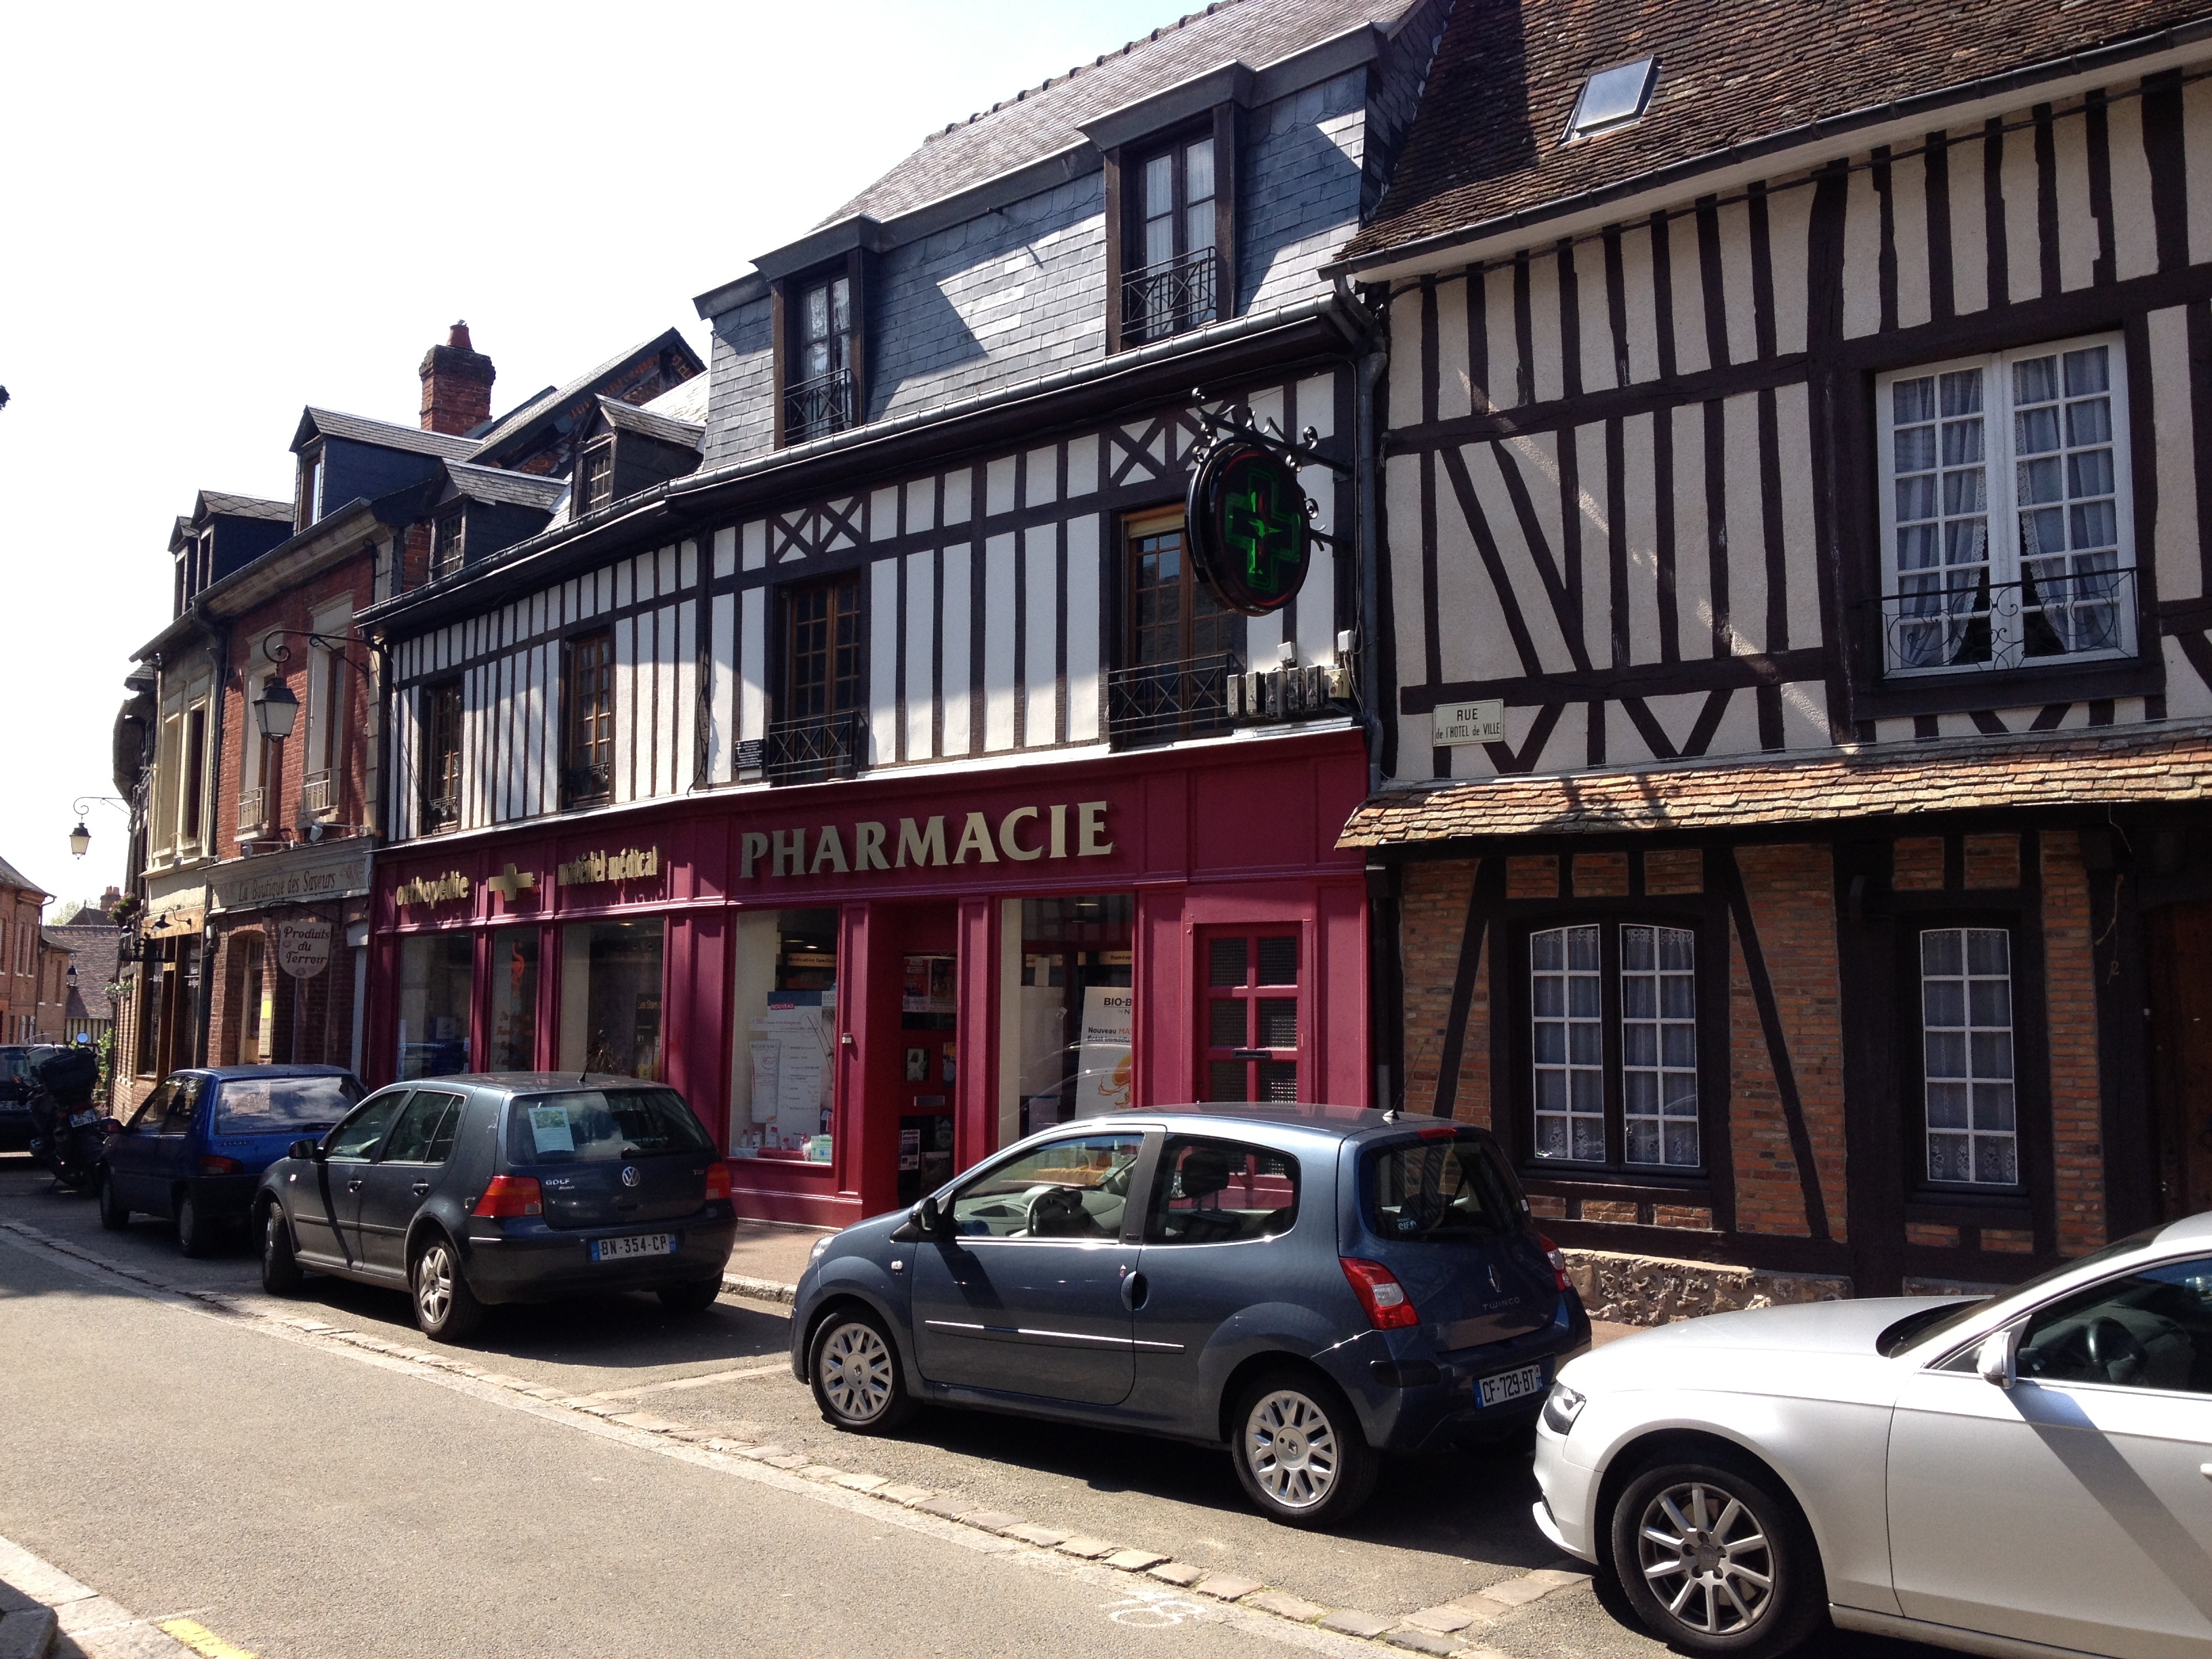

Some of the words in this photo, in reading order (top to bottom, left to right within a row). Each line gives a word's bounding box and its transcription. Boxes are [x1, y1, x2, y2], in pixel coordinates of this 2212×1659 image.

[1456, 708, 1478, 721] RUE
[1435, 728, 1443, 739] de
[1472, 724, 1480, 736] de
[1483, 722, 1500, 735] VILLE
[739, 800, 1114, 879] PHARMACIE
[557, 849, 606, 886] matériel
[608, 845, 658, 880] médical
[239, 882, 248, 902] La
[252, 879, 285, 899] Boutique
[287, 873, 300, 894] des
[303, 870, 335, 892] Saveurs
[396, 871, 470, 909] orthopédie
[283, 926, 331, 940] Produits
[298, 941, 312, 951] du
[286, 951, 327, 964] Terroir
[1088, 1027, 1117, 1035] Nouveau
[545, 1178, 571, 1186] GOLF
[1397, 1221, 1410, 1230] elf
[1481, 1296, 1521, 1311] TWINGO
[1482, 1368, 1534, 1404] CF-729-BT
